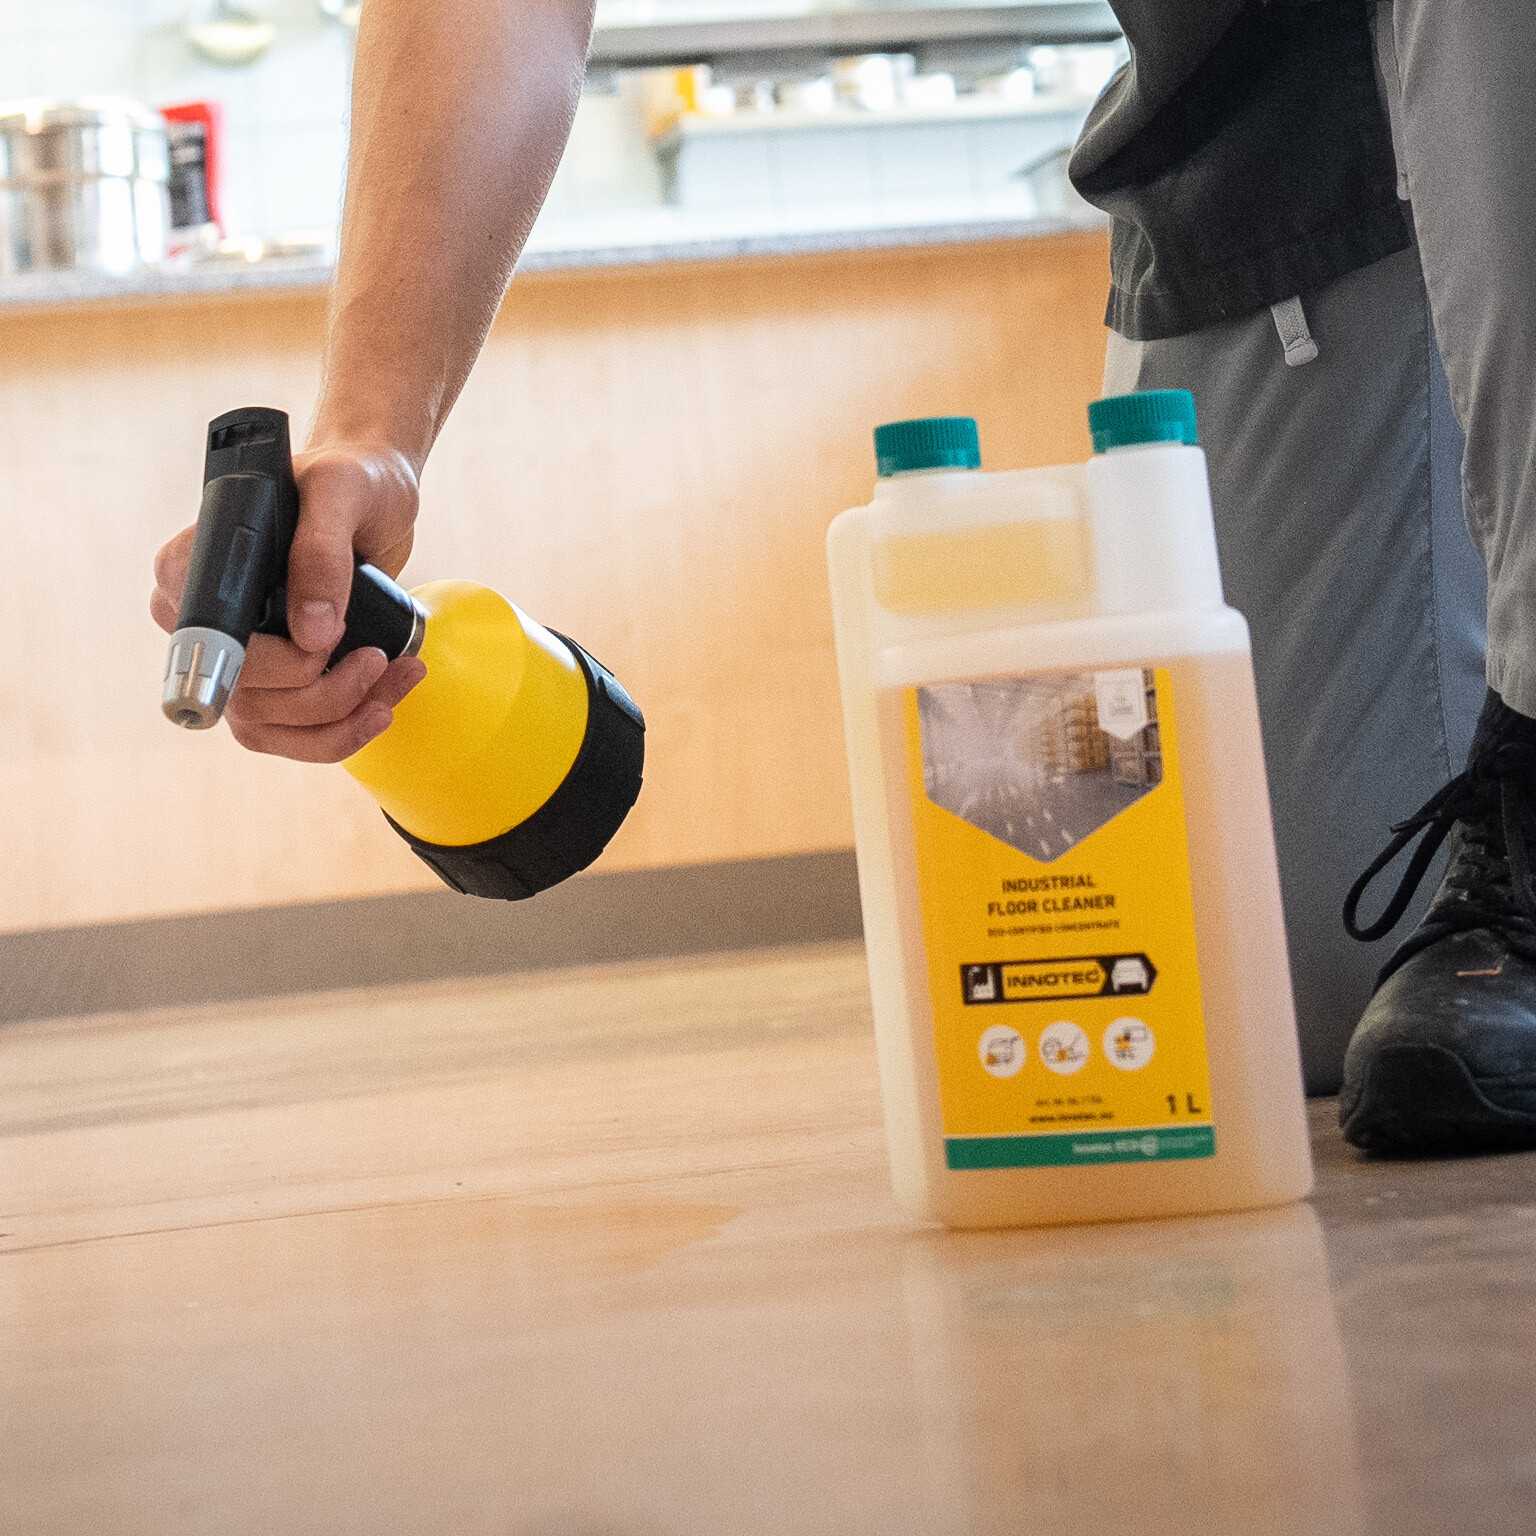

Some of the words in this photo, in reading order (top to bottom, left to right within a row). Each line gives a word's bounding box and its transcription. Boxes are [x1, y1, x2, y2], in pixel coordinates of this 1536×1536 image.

[1002, 873, 1096, 893] INDUSTRIAL
[987, 899, 1037, 916] FLOOR
[1042, 895, 1115, 913] CLEANER
[1007, 969, 1101, 988] INNOTEC
[1166, 1094, 1177, 1115] 1
[1186, 1092, 1202, 1114] L
